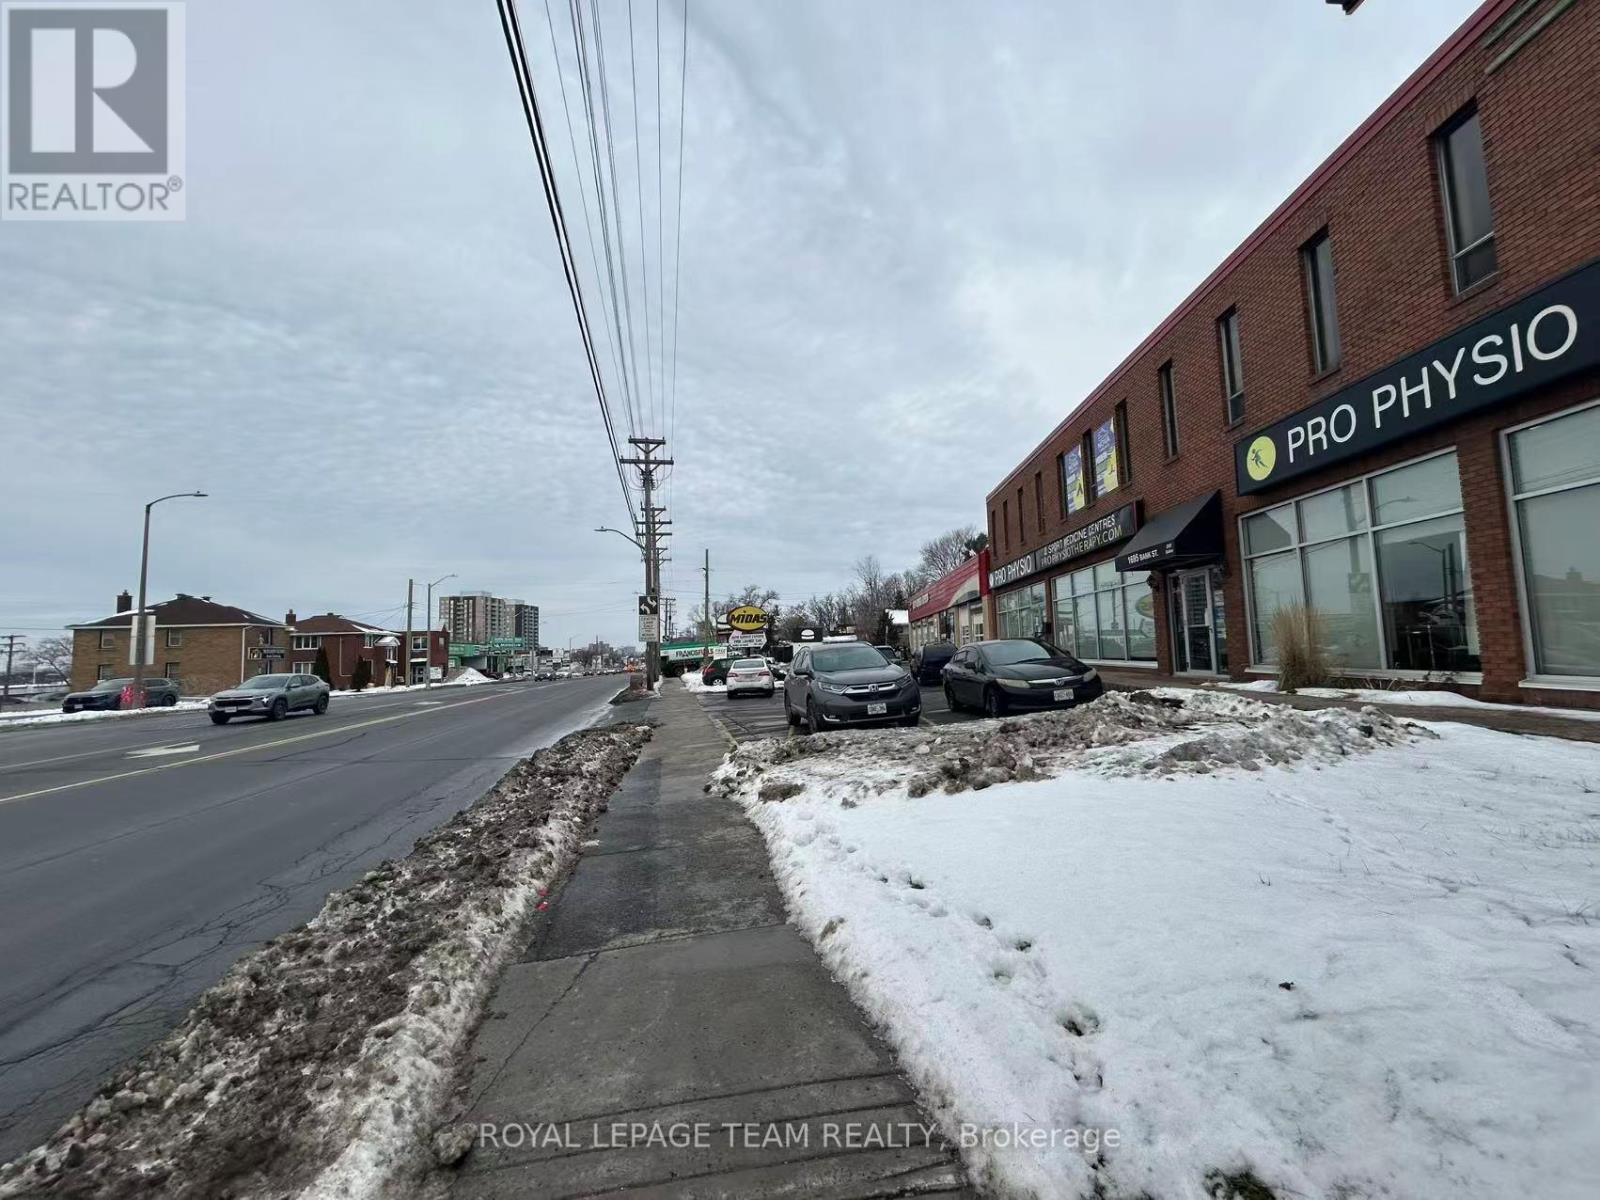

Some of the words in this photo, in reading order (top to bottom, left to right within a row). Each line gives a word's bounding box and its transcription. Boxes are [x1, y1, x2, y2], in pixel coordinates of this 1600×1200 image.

[1287, 403, 1357, 463] PRO
[1371, 304, 1578, 429] PHYSIO
[1041, 524, 1123, 568] PROPHYSIOTHERAPY.COM
[1048, 540, 1063, 554] SPORT
[1063, 528, 1088, 548] MEDICINE
[1088, 514, 1116, 537] CENTRES
[993, 564, 1006, 584] PRO
[1007, 554, 1032, 581] PHYSIO
[731, 610, 768, 624] MIDAS
